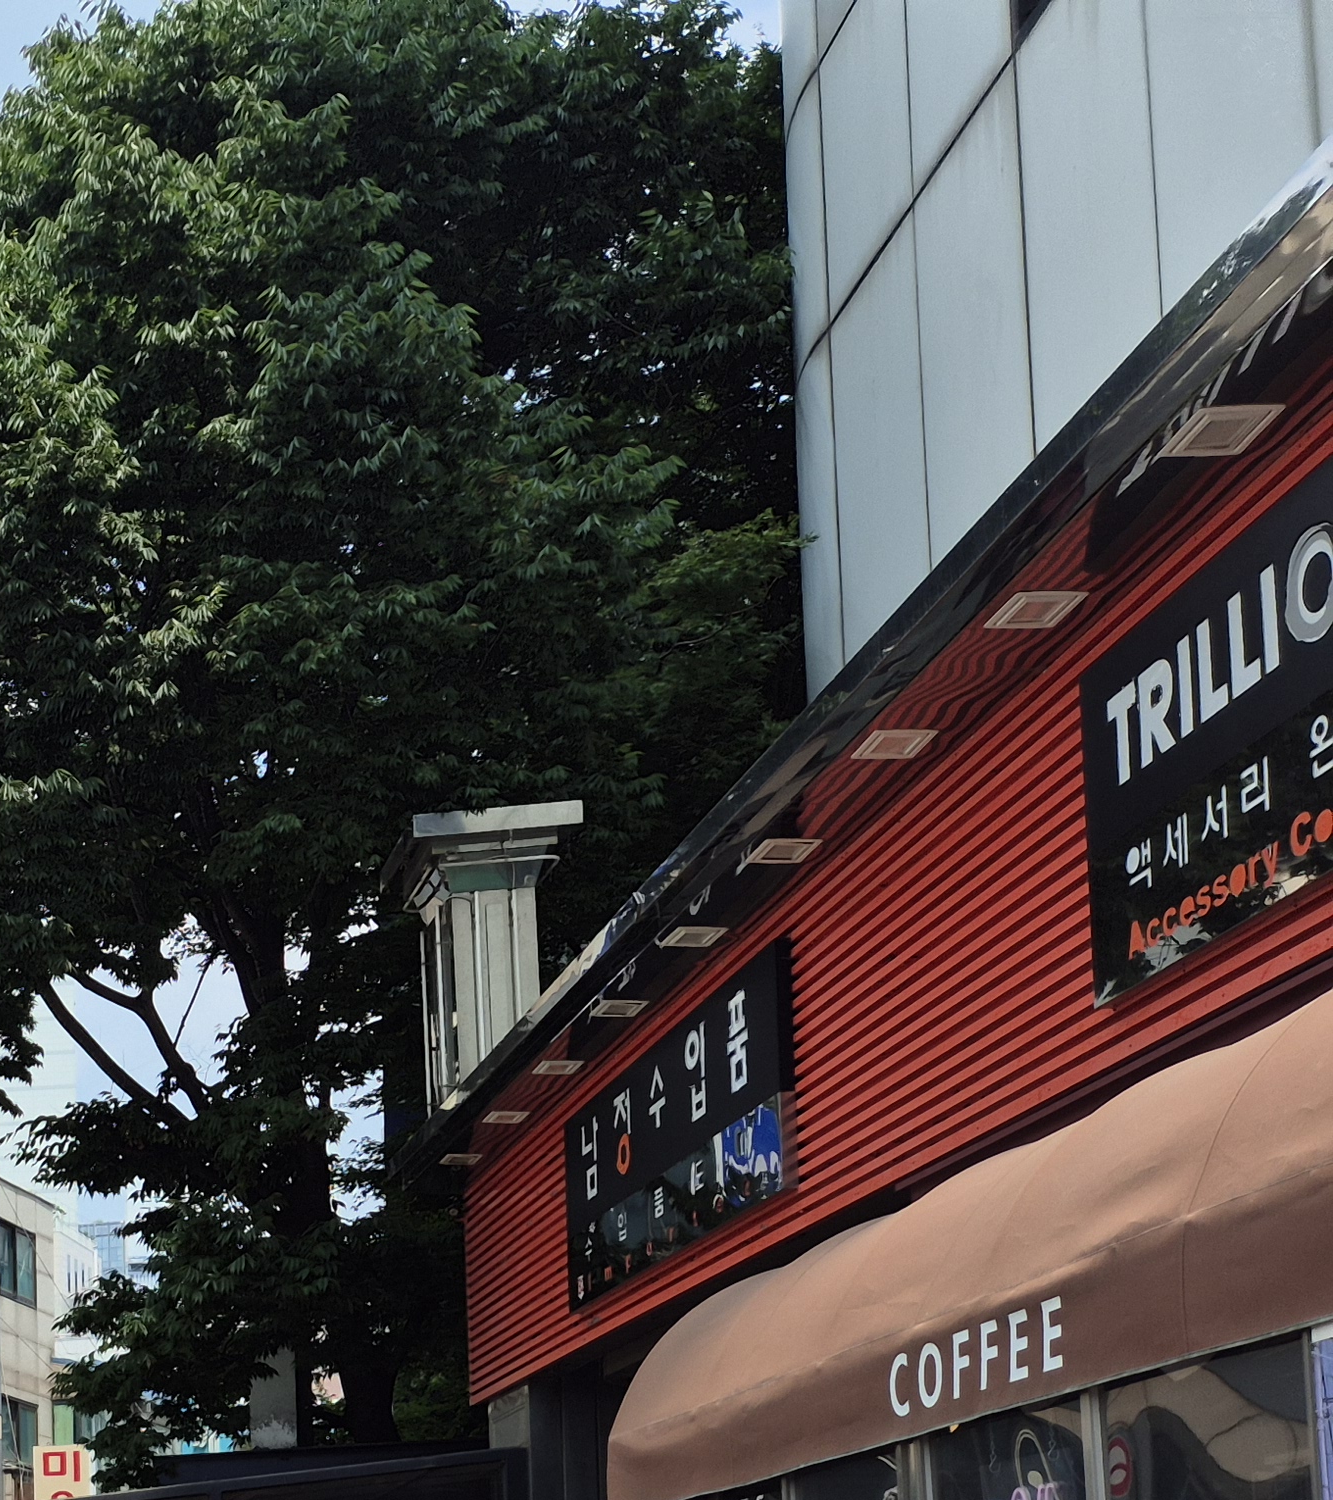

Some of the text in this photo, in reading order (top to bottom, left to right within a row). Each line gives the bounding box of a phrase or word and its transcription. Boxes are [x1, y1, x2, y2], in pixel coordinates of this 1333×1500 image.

[1125, 756, 1271, 888] 액세서리
[1129, 840, 1279, 958] Accessory
[581, 989, 749, 1200] 남정수입품
[889, 1296, 1063, 1417] COFFEE
